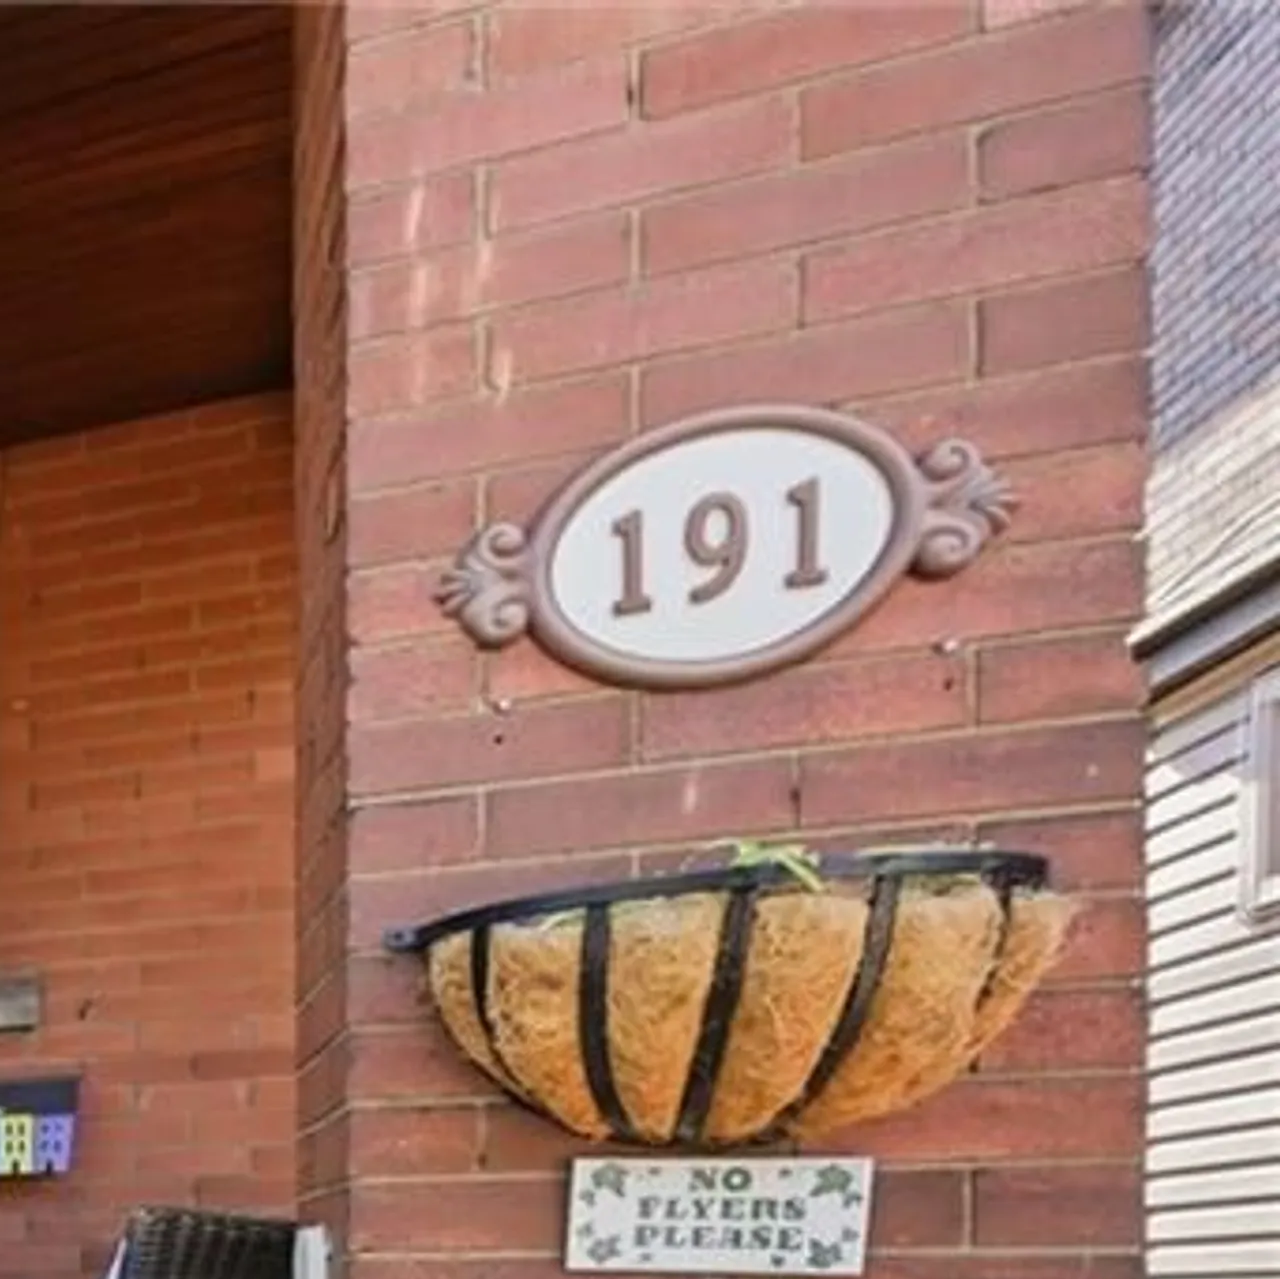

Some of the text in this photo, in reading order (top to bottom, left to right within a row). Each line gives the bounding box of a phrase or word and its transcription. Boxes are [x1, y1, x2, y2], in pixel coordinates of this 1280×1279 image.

[611, 475, 827, 617] 191
[690, 1166, 752, 1193] NO
[637, 1197, 806, 1221] FLYERS
[633, 1226, 804, 1251] PLEASE
